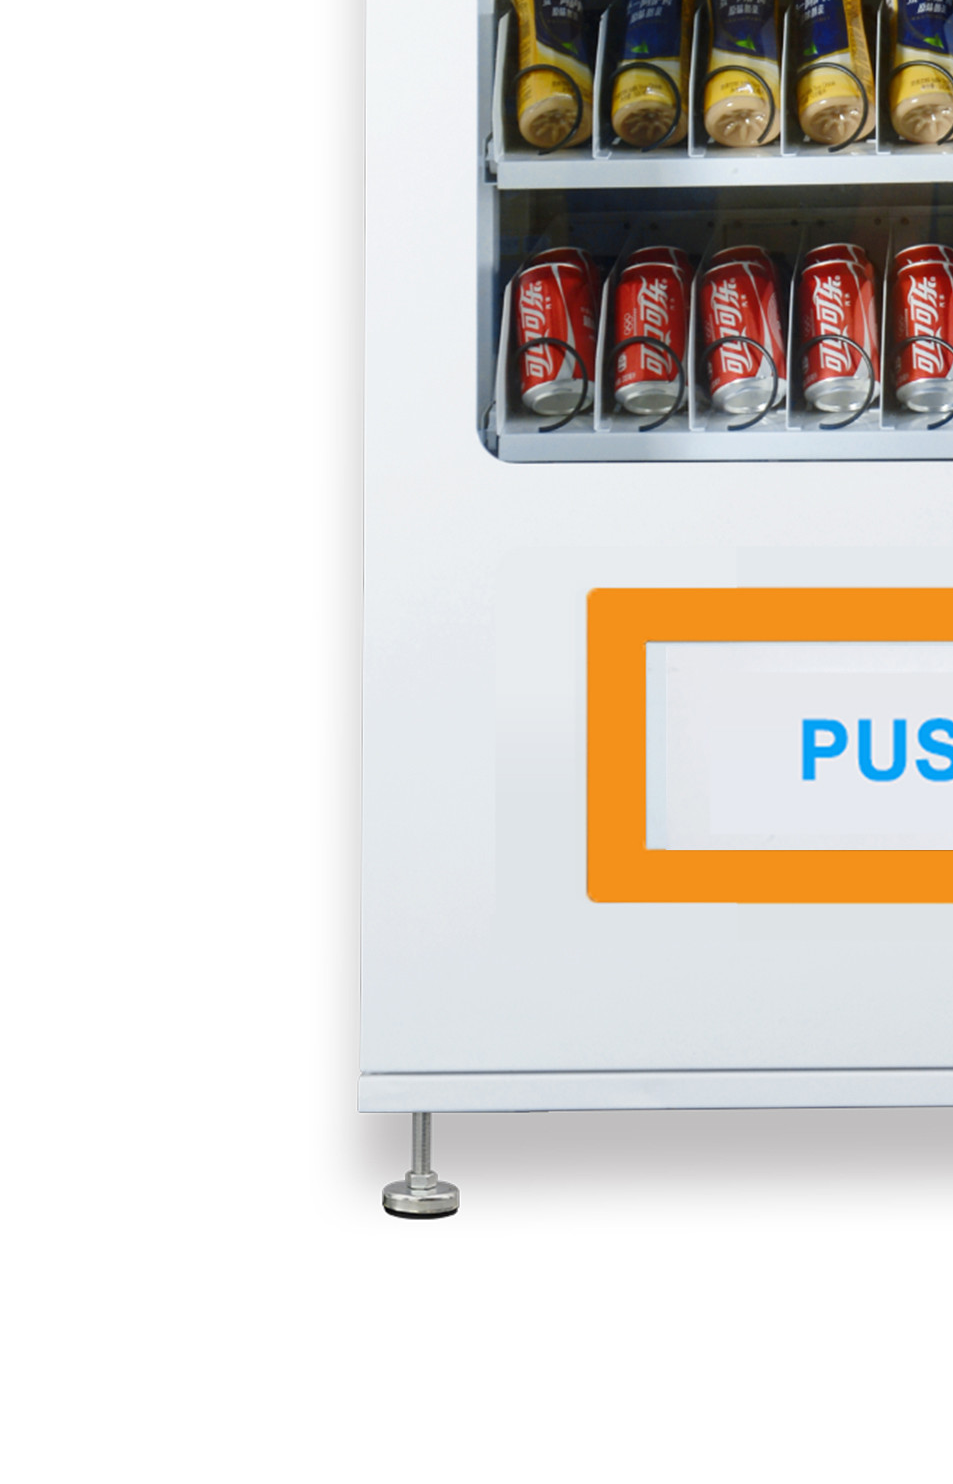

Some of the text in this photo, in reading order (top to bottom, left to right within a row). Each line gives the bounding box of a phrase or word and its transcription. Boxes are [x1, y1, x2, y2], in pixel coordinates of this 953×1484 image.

[519, 279, 553, 378] 可口可乐
[638, 276, 672, 376] 可口可乐
[710, 280, 753, 374] 可口可乐
[813, 275, 852, 373] 可口可乐
[908, 275, 944, 374] 可口可乐
